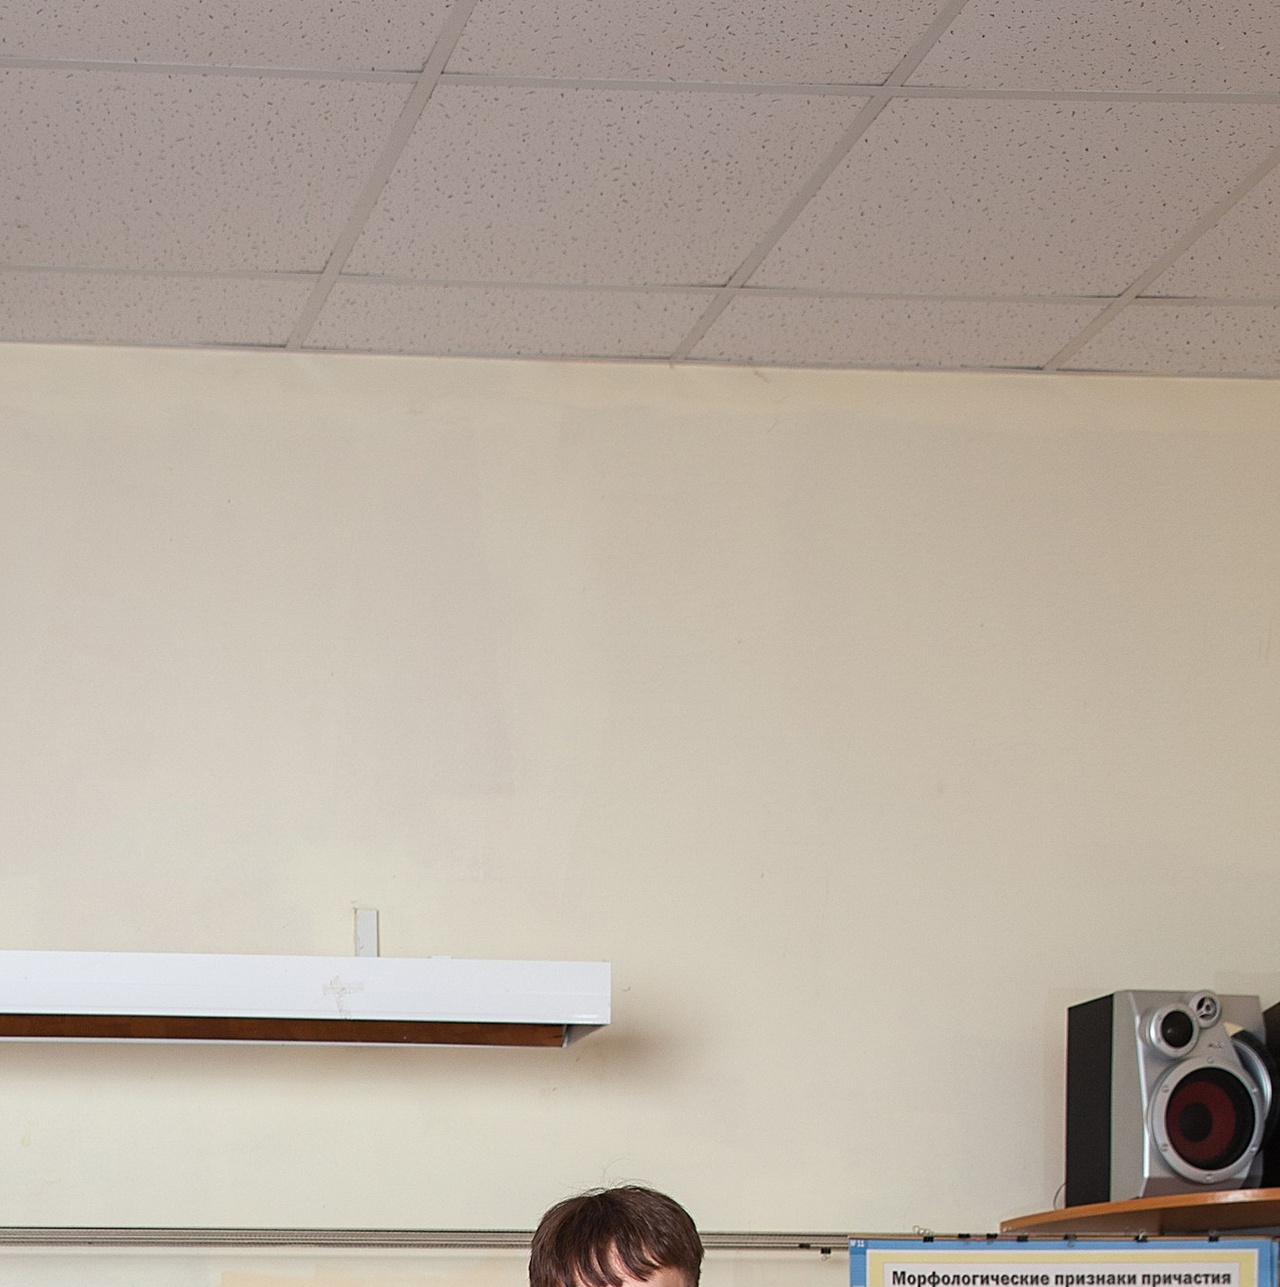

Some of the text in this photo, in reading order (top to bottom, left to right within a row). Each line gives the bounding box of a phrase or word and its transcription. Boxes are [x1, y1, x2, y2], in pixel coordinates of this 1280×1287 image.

[892, 1271, 1231, 1287] Морфологические признаки причастия
